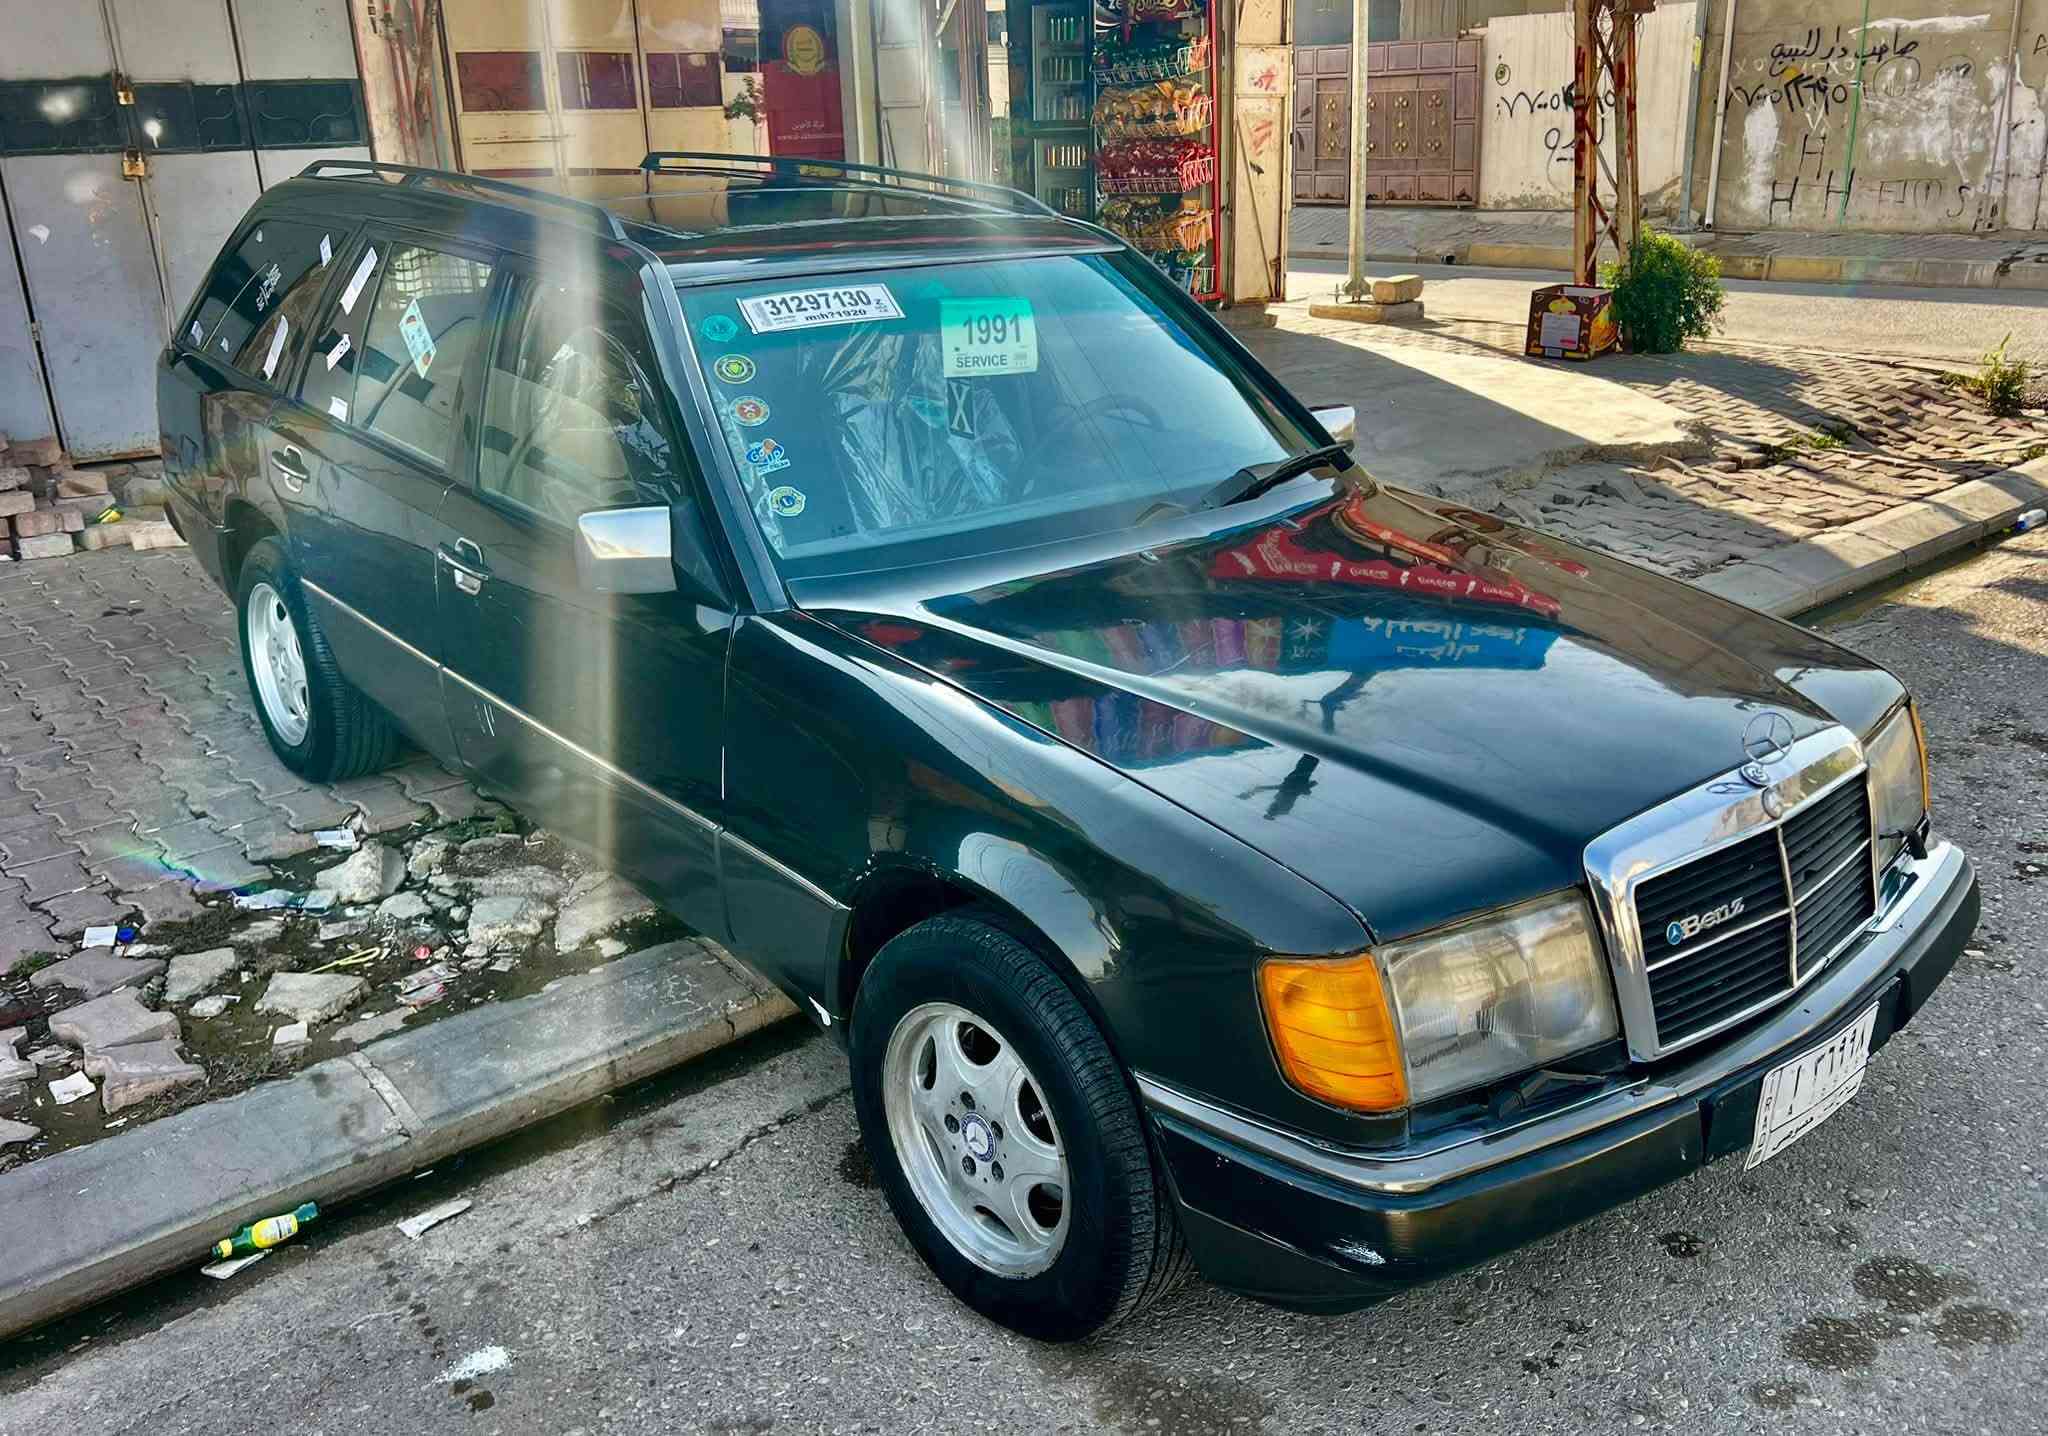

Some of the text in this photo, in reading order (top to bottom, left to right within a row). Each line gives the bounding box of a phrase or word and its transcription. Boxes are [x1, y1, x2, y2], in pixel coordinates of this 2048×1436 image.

[764, 290, 872, 316] 31297130
[963, 312, 1020, 345] 1991
[955, 354, 1008, 369] SERVICE
[1680, 896, 1745, 940] Benz
